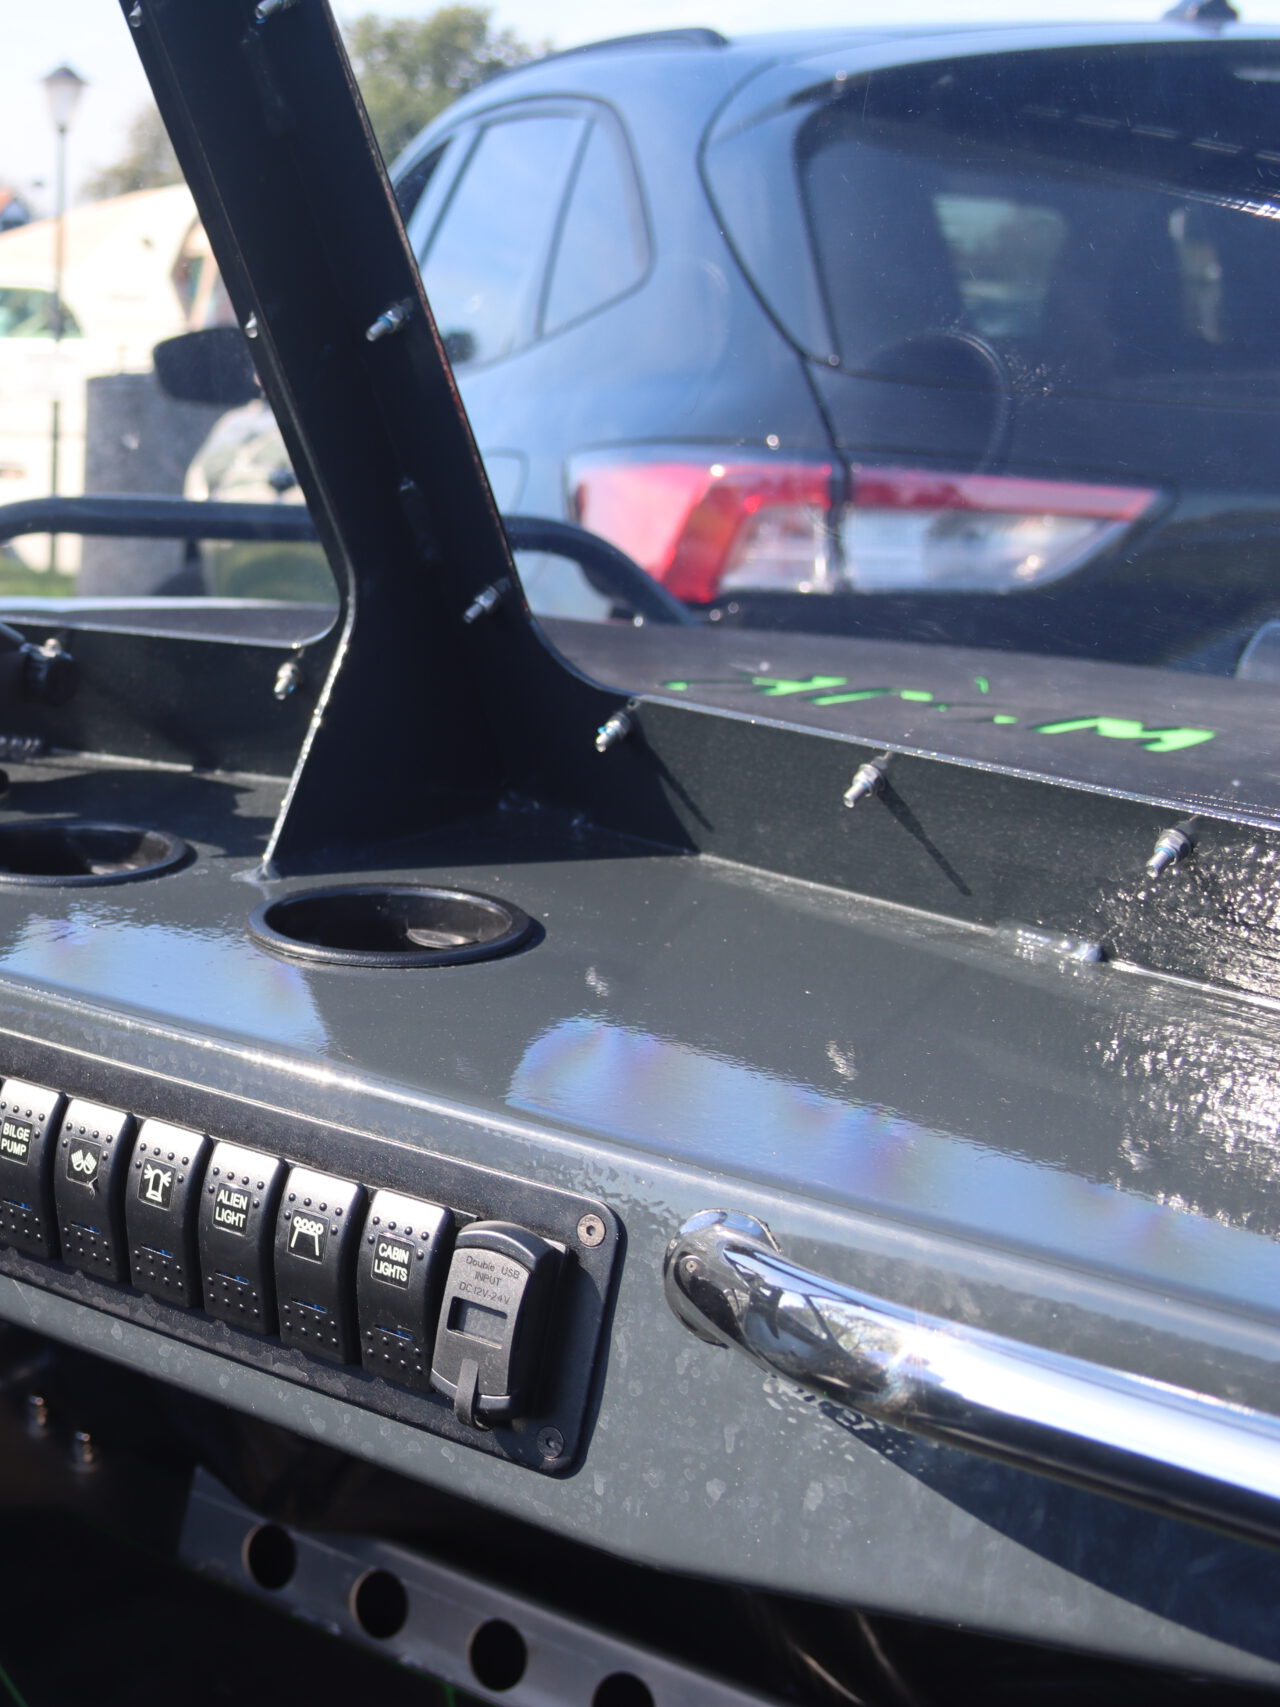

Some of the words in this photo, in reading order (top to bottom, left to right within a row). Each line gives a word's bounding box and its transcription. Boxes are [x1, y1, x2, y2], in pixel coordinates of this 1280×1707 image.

[2, 1122, 31, 1142] BILGE
[0, 1139, 27, 1157] PUMP
[217, 1189, 248, 1210] ALIEN
[215, 1206, 246, 1228] LIGHT
[378, 1243, 409, 1265] CABIN
[374, 1259, 408, 1282] LIGHTS
[465, 1255, 496, 1272] Double
[501, 1265, 520, 1279] USB
[474, 1271, 502, 1286] INPUT
